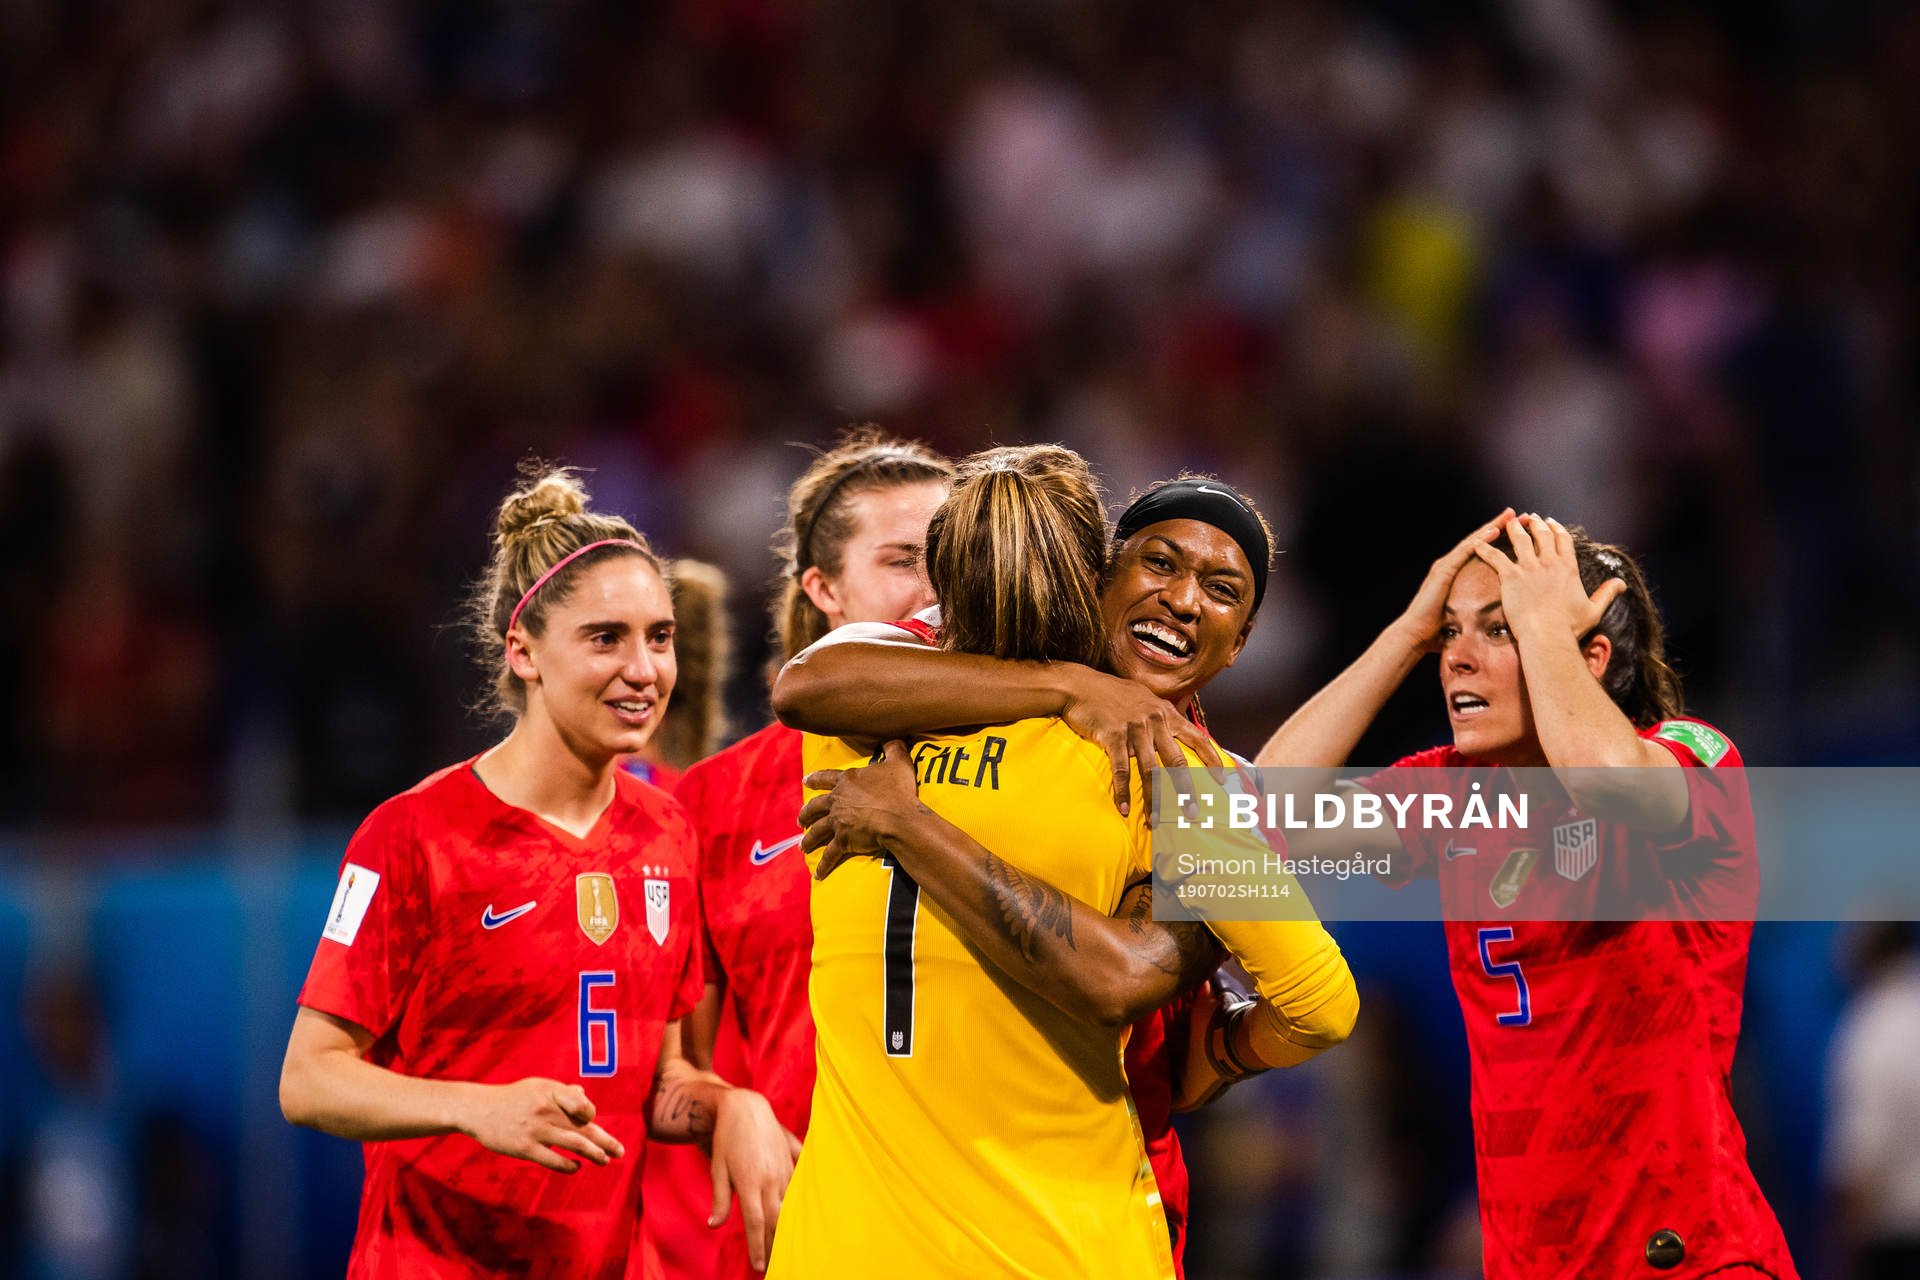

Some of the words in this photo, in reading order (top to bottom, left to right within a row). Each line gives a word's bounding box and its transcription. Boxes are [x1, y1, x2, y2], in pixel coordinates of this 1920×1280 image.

[1558, 822, 1593, 848] USA
[881, 850, 920, 1058] 1
[1477, 927, 1532, 1027] 5
[578, 970, 617, 1078] 6
